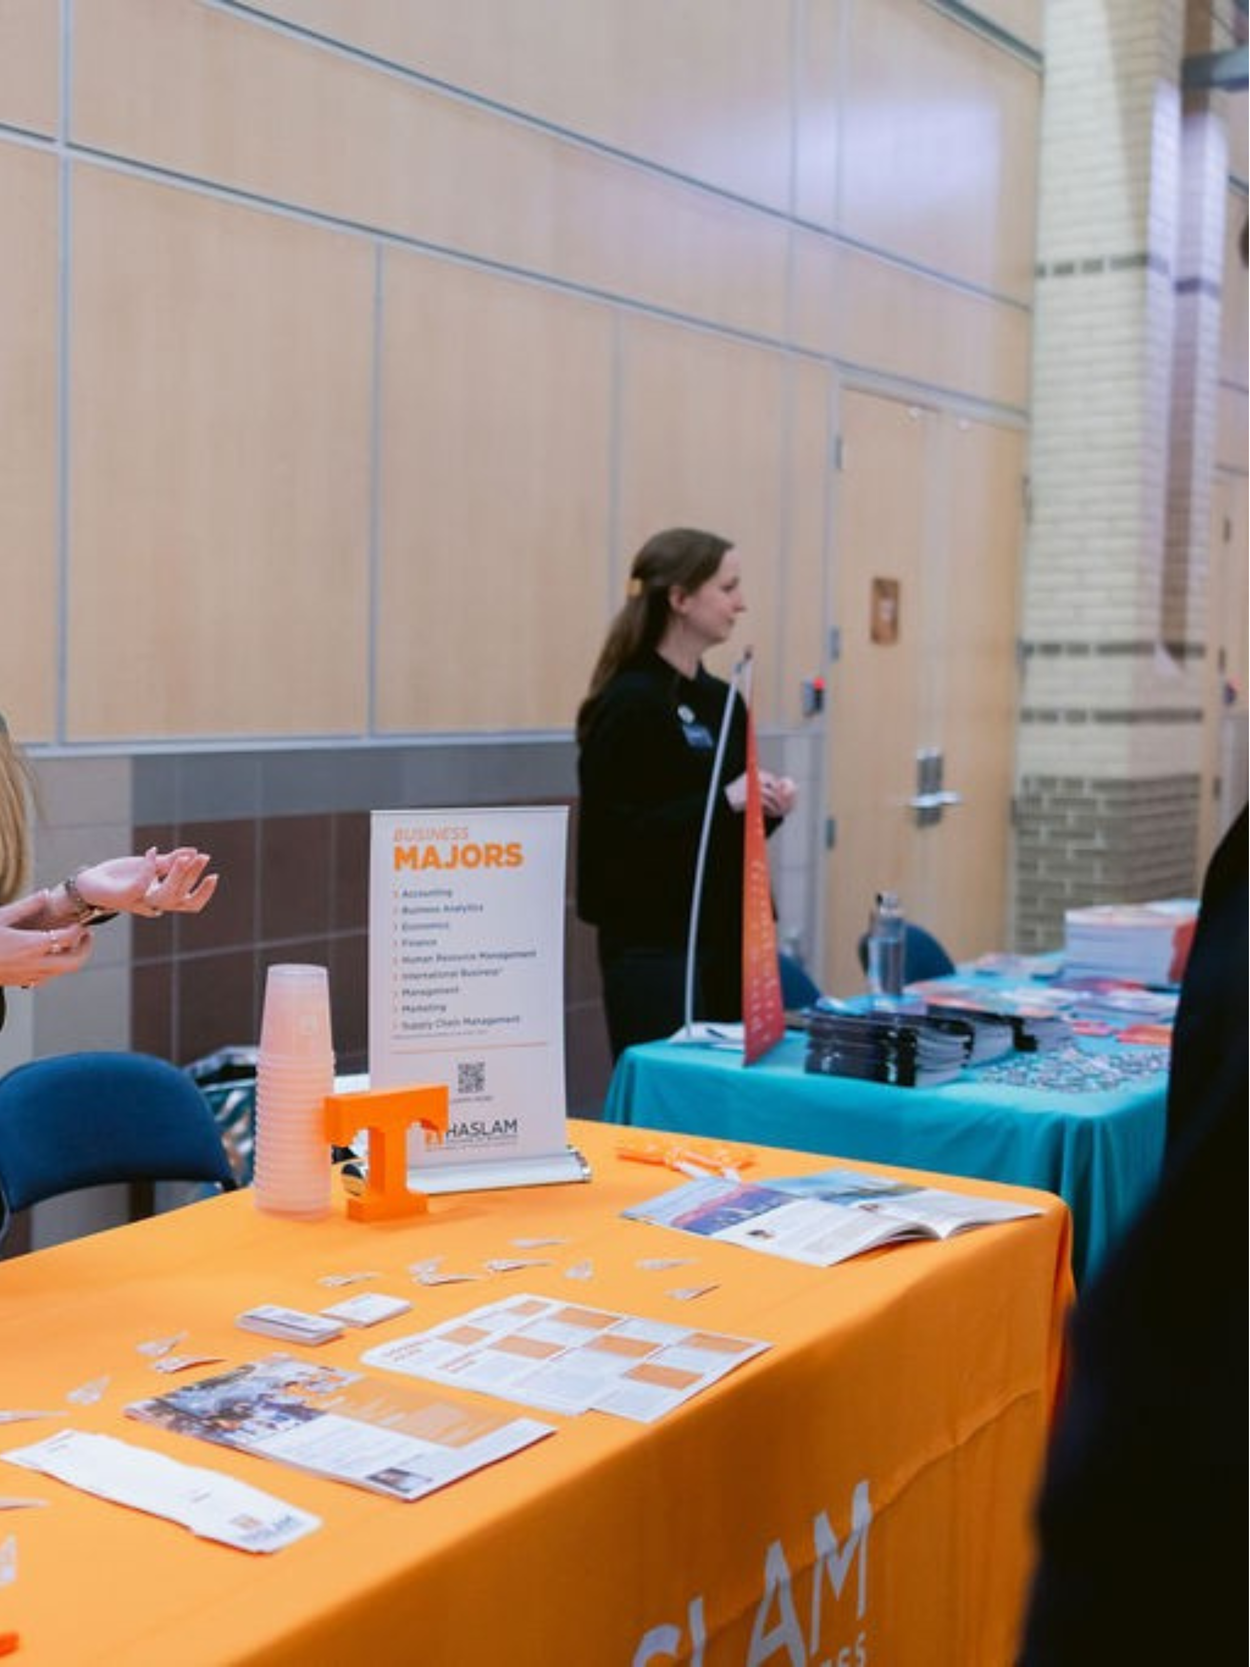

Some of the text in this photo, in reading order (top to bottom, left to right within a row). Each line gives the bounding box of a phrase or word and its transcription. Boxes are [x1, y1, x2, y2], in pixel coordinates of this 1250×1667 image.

[393, 827, 469, 842] BUSINESS
[393, 843, 524, 872] MAJORS
[402, 889, 453, 899] Accounting
[402, 903, 483, 915] Business Analytics
[402, 922, 449, 931] Economics
[402, 939, 437, 948] Finance
[402, 955, 434, 964] Human
[479, 950, 537, 961] Management
[402, 970, 459, 981] International
[402, 986, 459, 997] Management
[402, 1003, 447, 1014] Marketing
[402, 1015, 520, 1031] Supply Chain Management
[446, 1119, 518, 1139] HASLAM
